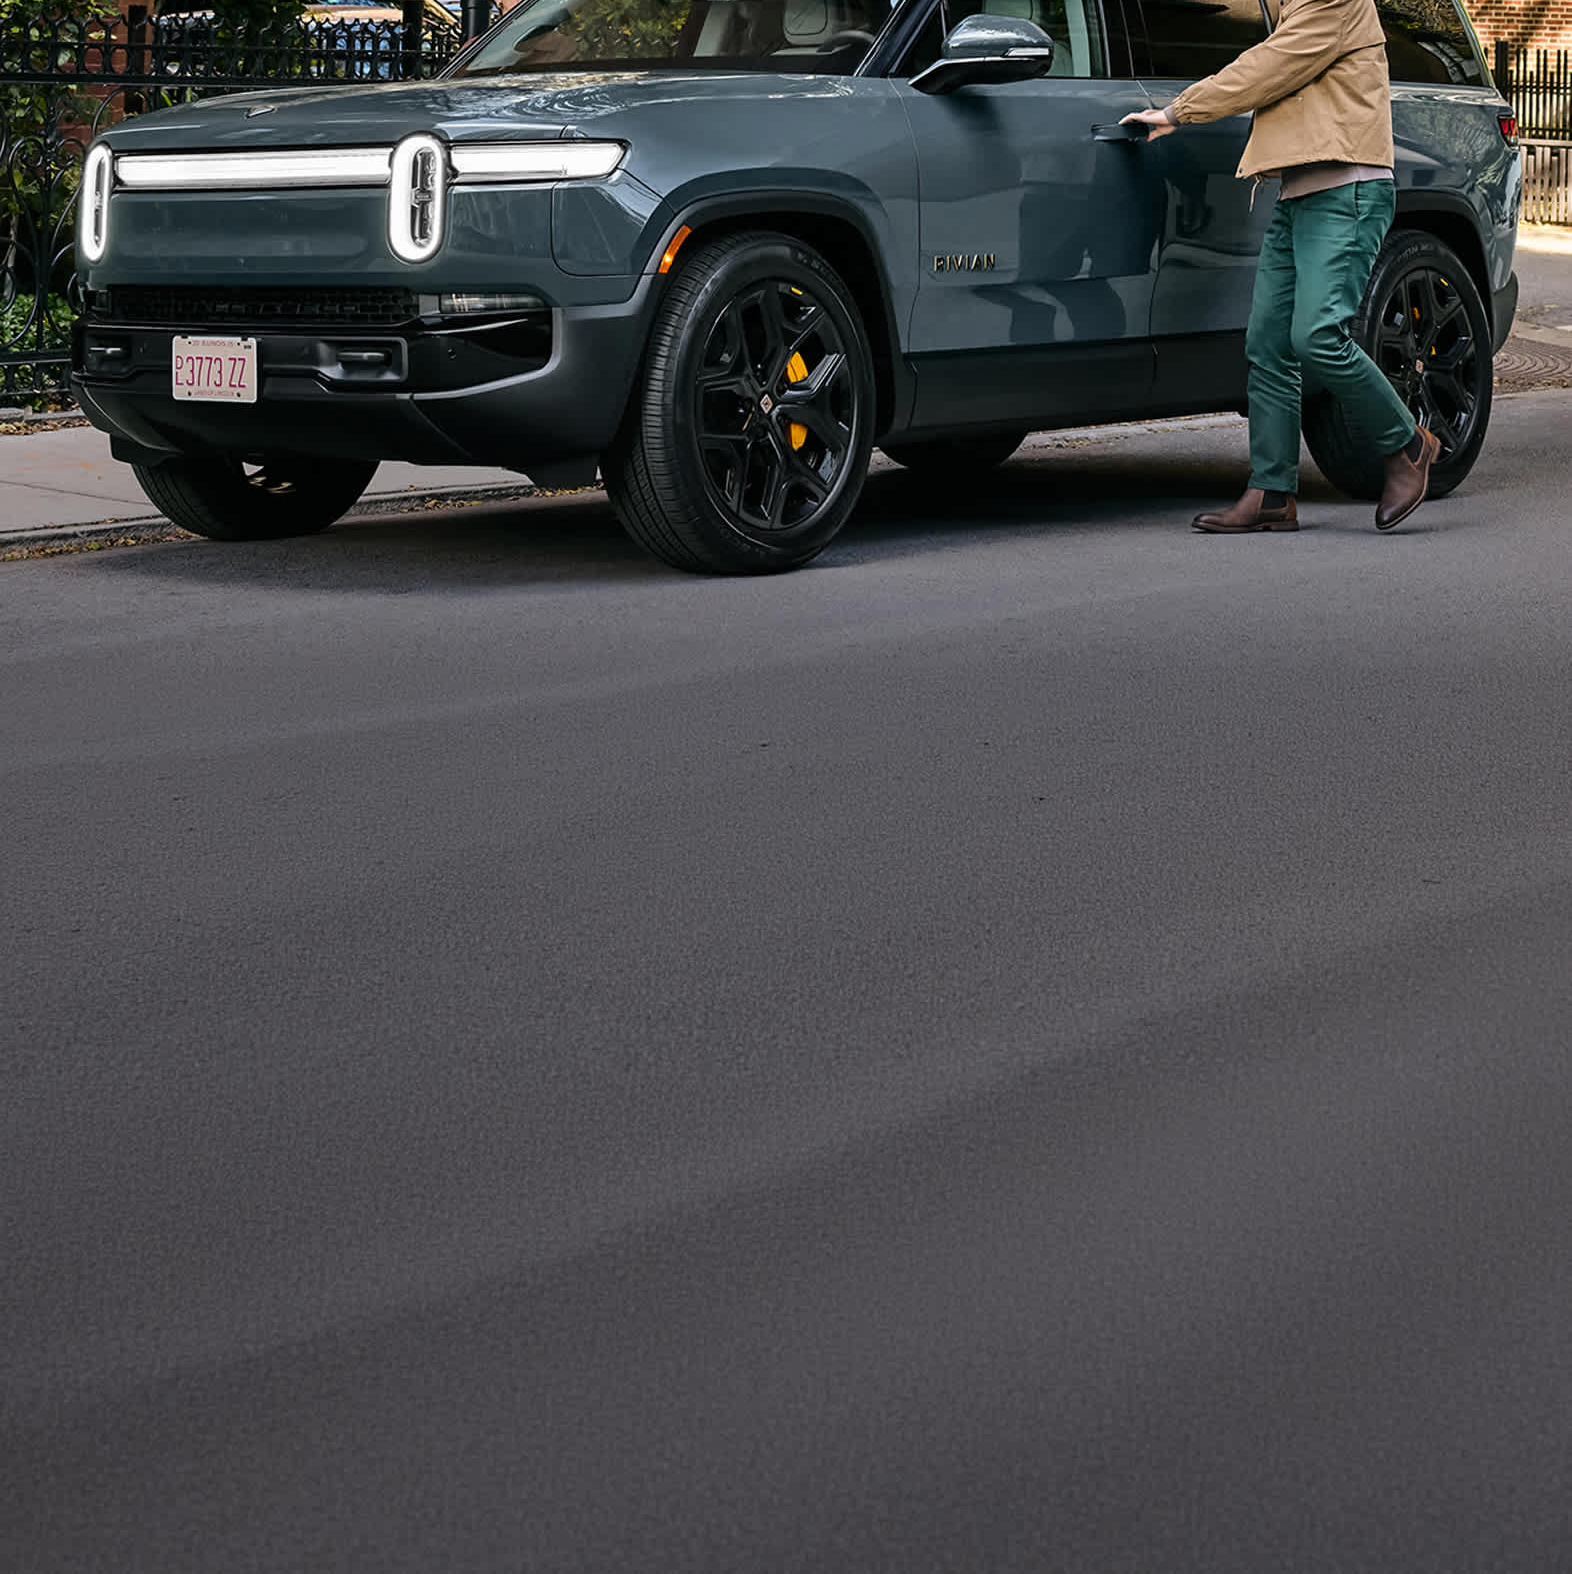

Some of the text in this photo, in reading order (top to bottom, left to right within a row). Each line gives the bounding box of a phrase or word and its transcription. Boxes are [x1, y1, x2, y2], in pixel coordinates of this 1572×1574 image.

[934, 253, 995, 272] RIVIAN
[185, 356, 223, 387] 3773
[228, 357, 247, 388] ZZ
